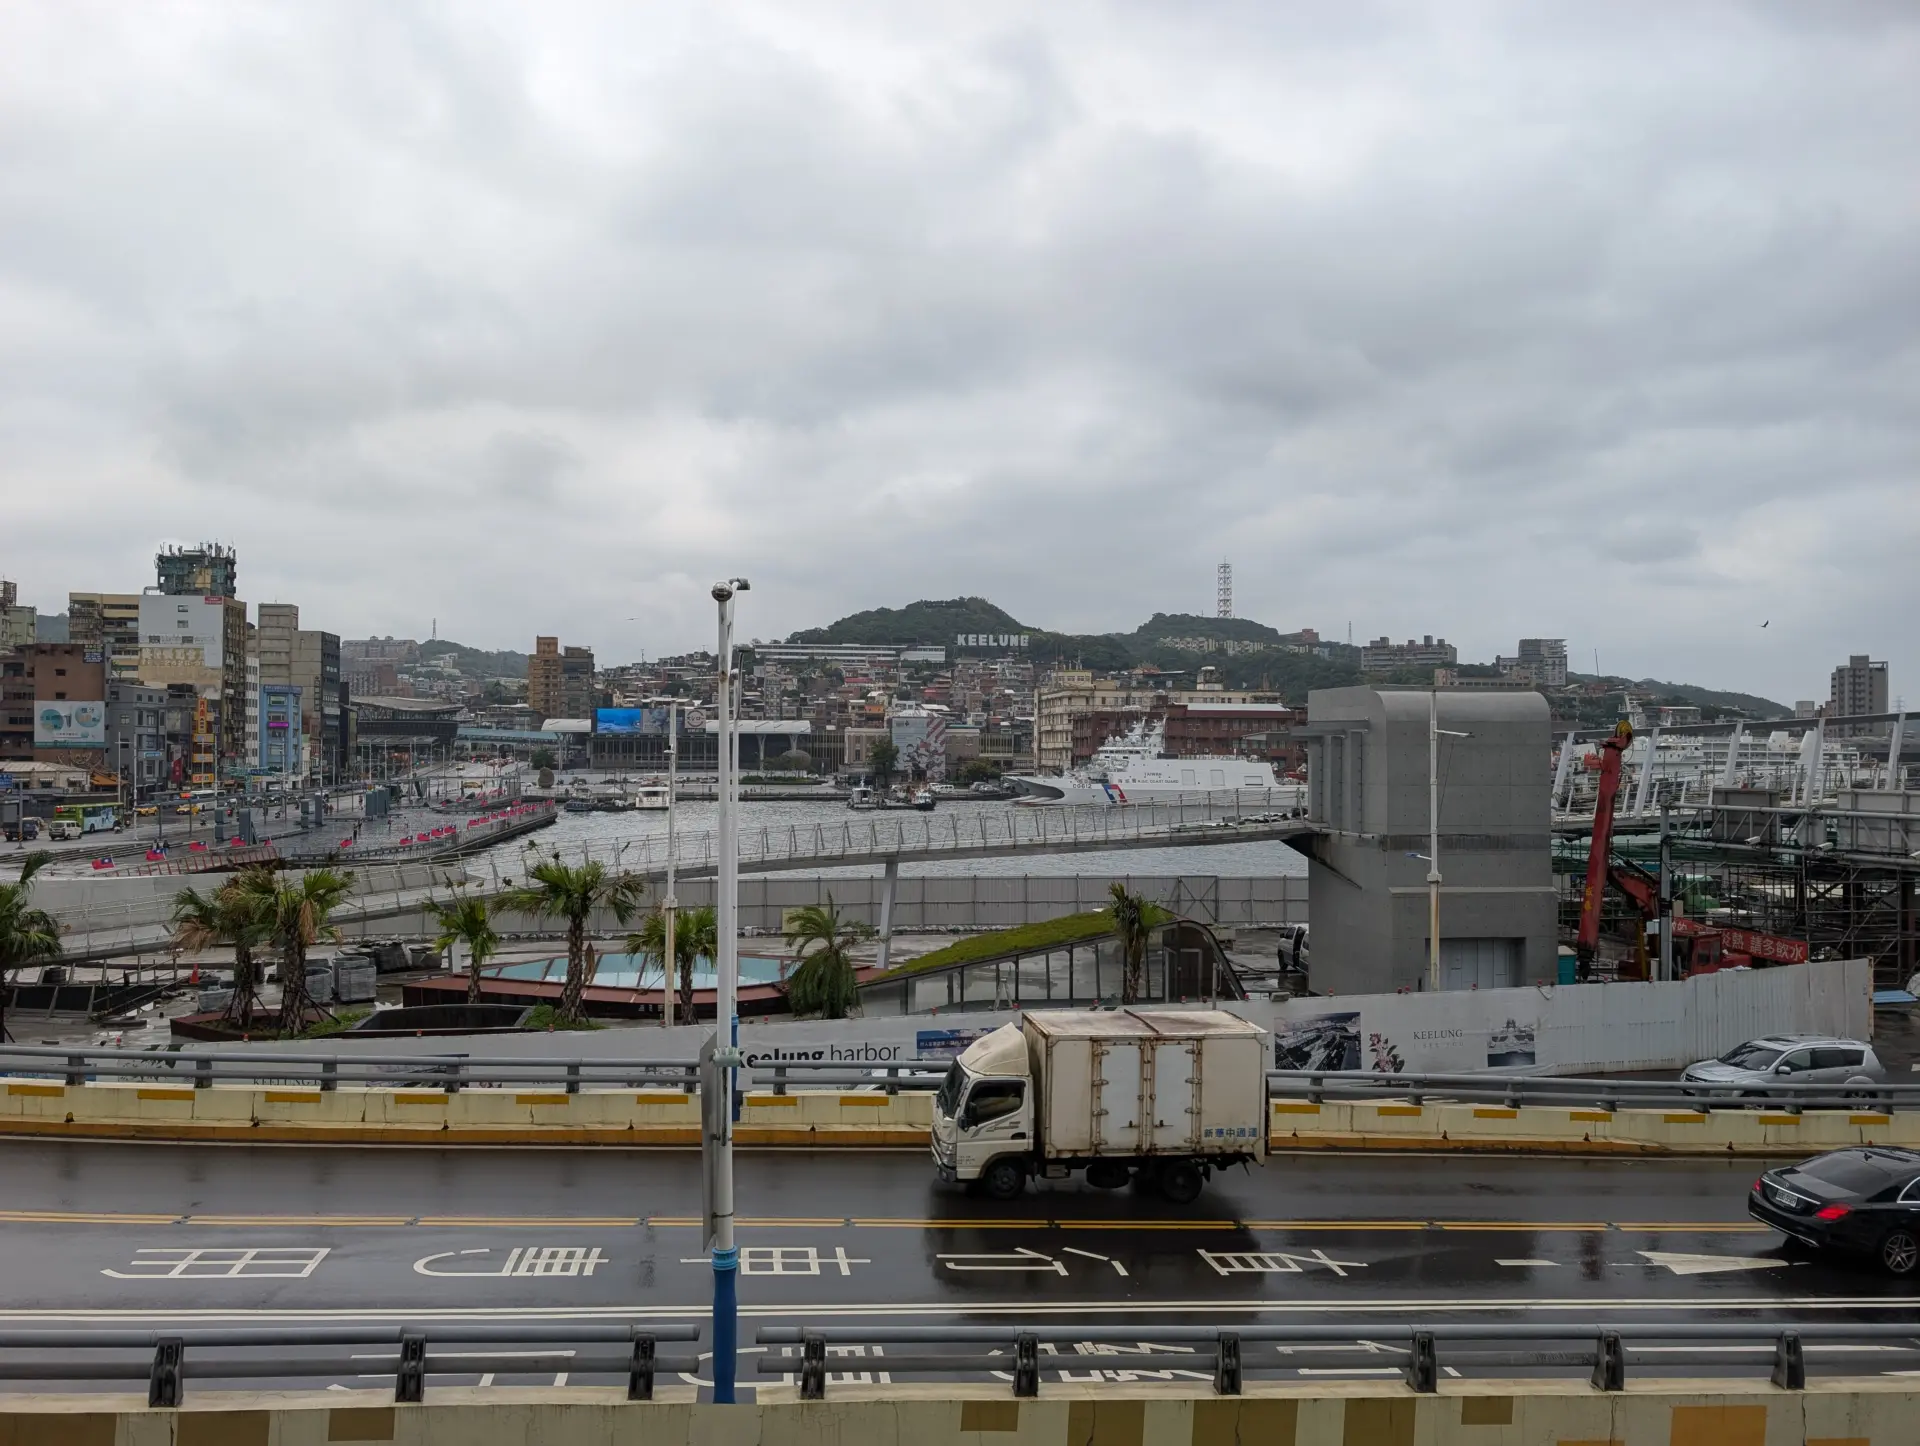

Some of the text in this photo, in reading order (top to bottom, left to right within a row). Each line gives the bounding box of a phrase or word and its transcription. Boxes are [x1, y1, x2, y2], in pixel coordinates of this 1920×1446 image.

[957, 634, 1029, 647] KEELUNG
[1750, 935, 1803, 961] 請多飲水
[1413, 1029, 1463, 1040] KEELUNG
[830, 1042, 901, 1062] harbor
